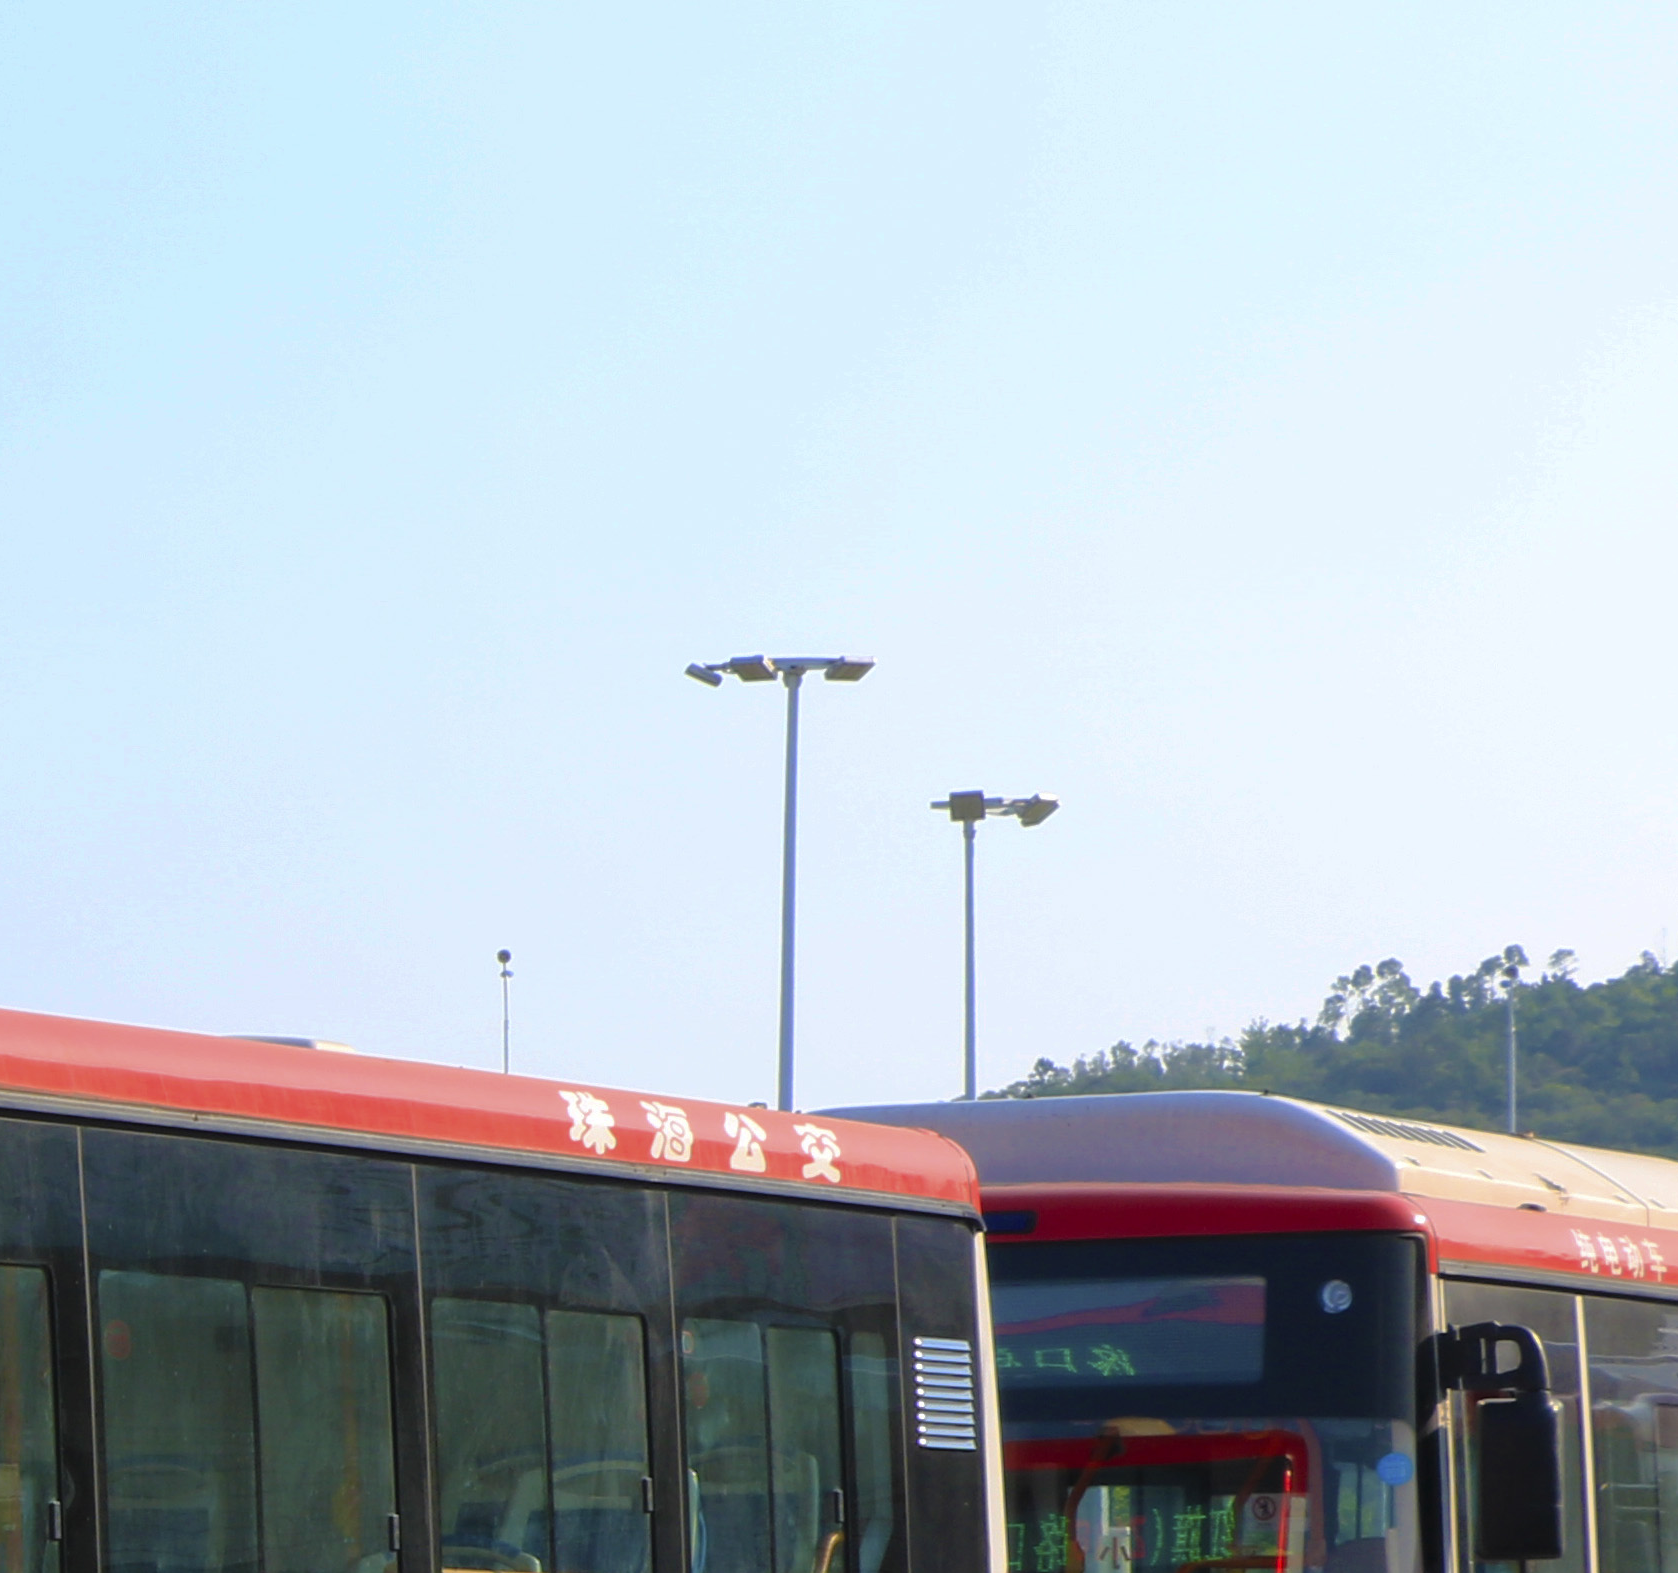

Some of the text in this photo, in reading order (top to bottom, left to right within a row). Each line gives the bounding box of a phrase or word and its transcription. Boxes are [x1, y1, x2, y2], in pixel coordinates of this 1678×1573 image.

[558, 1090, 842, 1184] 珠海公交
[1570, 1229, 1668, 1283] 纯电动车
